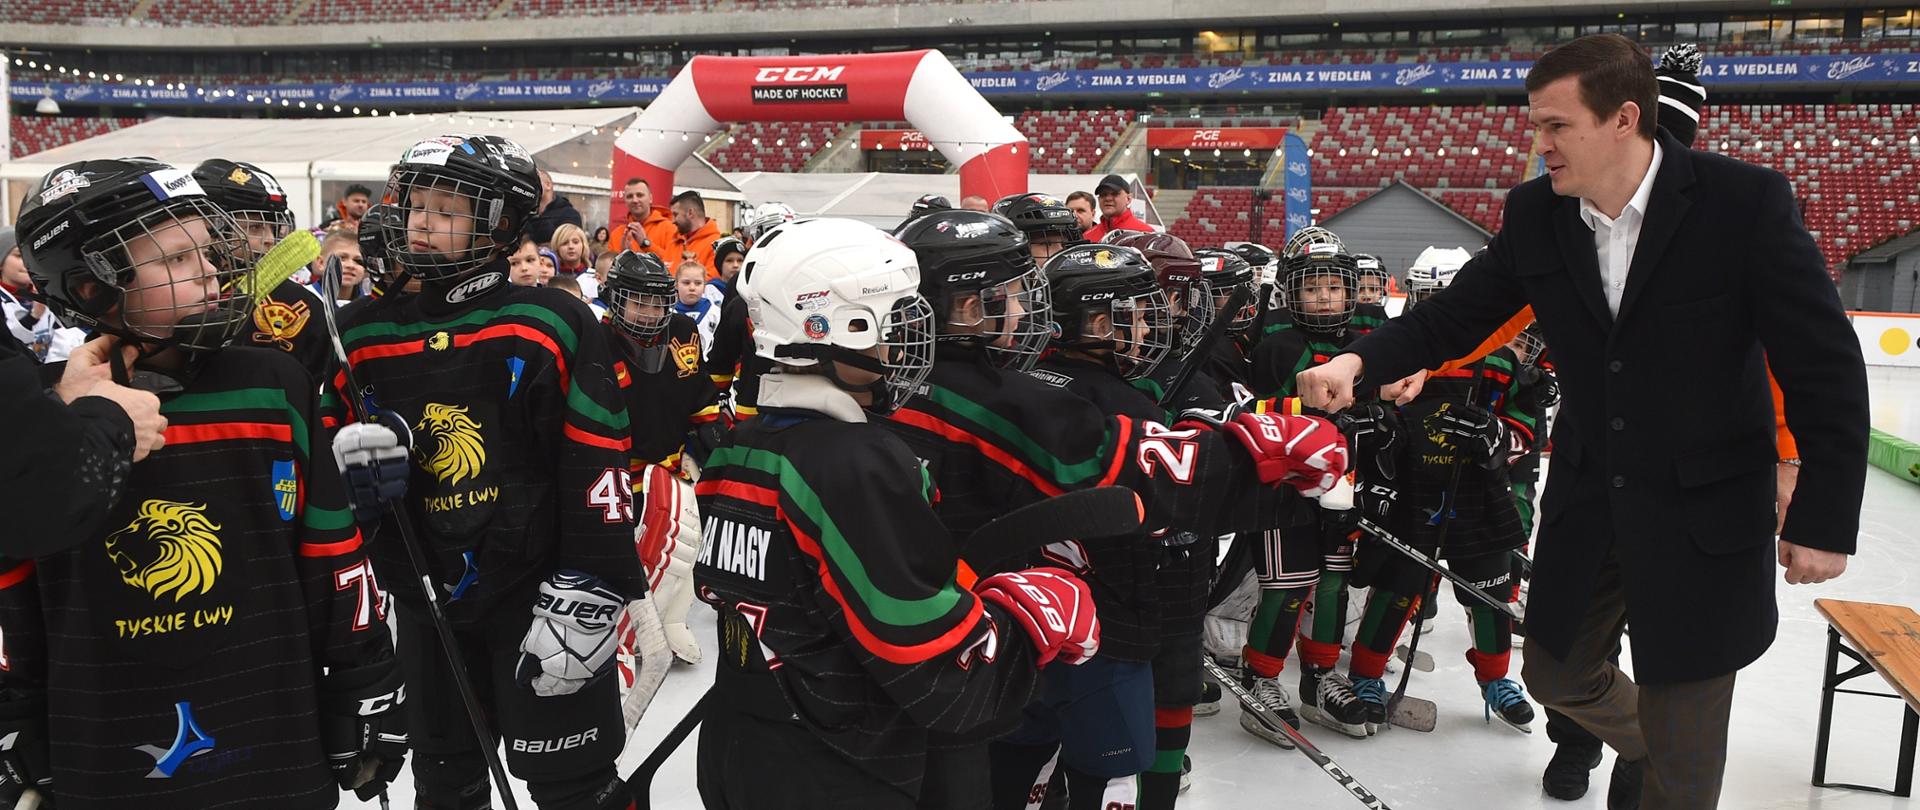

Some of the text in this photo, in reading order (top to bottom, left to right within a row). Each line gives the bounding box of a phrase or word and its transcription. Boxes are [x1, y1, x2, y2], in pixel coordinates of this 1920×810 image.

[755, 66, 845, 82] CCM
[1461, 69, 1497, 79] ZIMA
[1502, 69, 1511, 79] Z
[1718, 64, 1728, 75] Z
[1734, 63, 1798, 75] WEDLEM
[971, 77, 1016, 87] WEDLEM
[1091, 75, 1186, 86] ZIMA Z WEDLEM
[1268, 71, 1372, 82] ZIMA Z WEDLEM
[369, 88, 393, 96] ZIMA
[498, 86, 522, 95] ZIMA
[533, 86, 571, 94] WEDLEM
[633, 84, 659, 93] ZIMA
[754, 88, 843, 99] MADE OF HOCKEY
[901, 132, 923, 142] PGE
[1193, 130, 1221, 141] PGE
[947, 270, 986, 282] CCM
[796, 290, 830, 301] CCM
[1080, 291, 1115, 300] CCM
[424, 486, 499, 514] TYSKIE LWY
[716, 520, 772, 581] NAGY
[115, 605, 233, 639] TYSKIE LWY
[512, 727, 599, 753] BAUER
